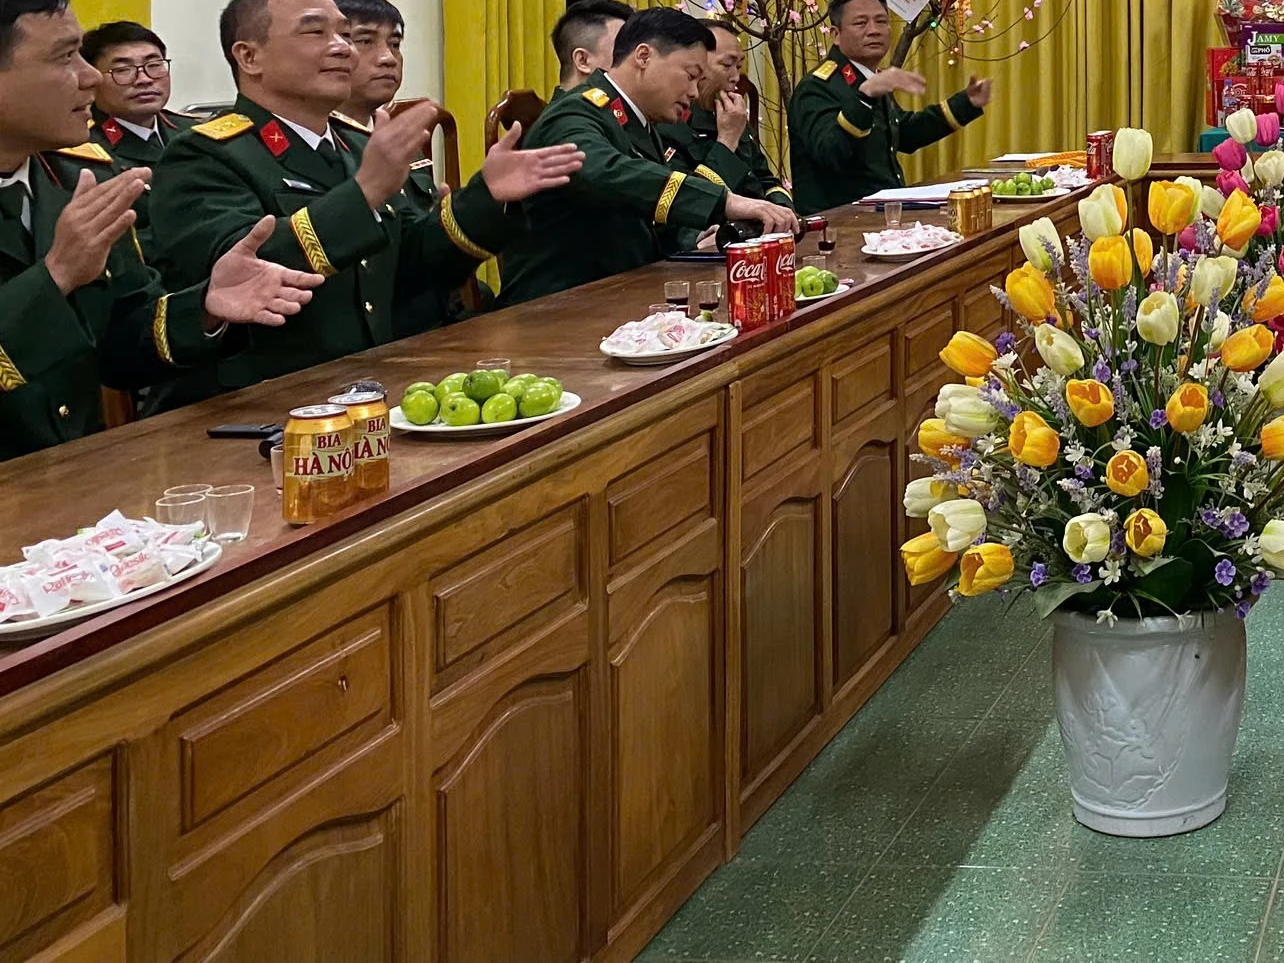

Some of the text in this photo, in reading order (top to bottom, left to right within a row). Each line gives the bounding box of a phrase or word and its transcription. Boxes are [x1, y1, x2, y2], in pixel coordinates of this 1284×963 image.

[367, 417, 386, 433] BIA
[317, 433, 342, 449] BIA
[294, 452, 323, 476] HÀ
